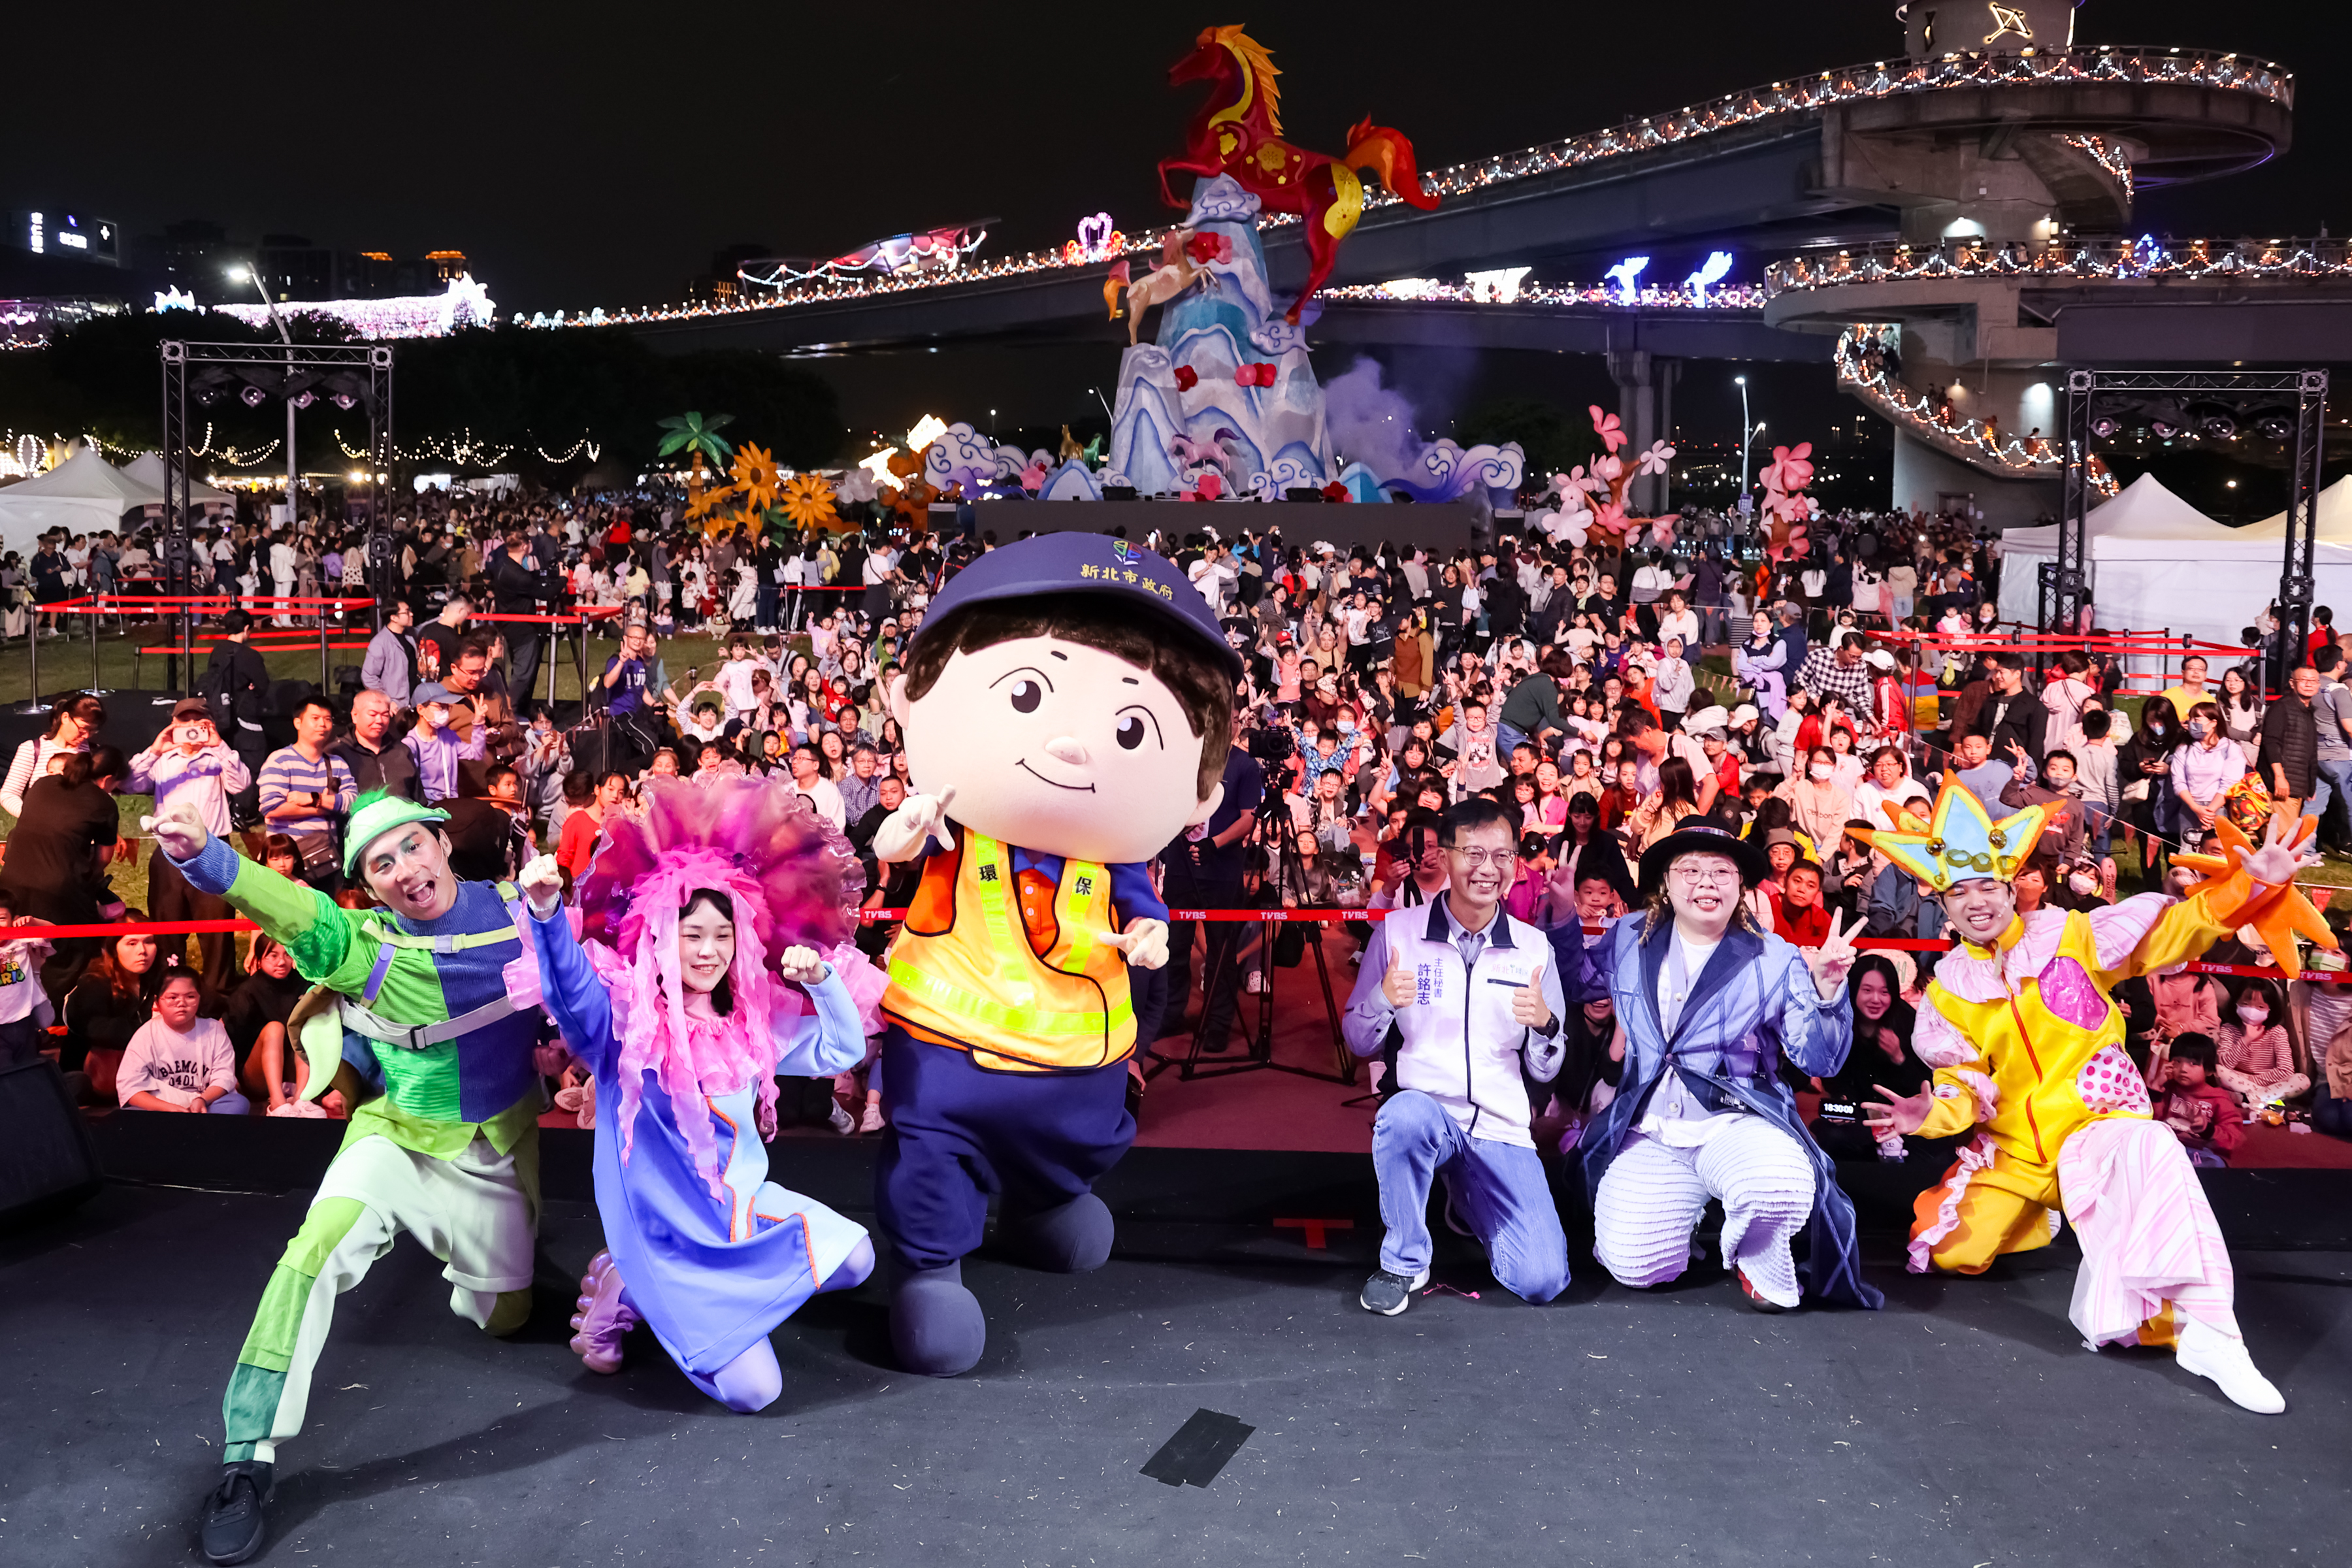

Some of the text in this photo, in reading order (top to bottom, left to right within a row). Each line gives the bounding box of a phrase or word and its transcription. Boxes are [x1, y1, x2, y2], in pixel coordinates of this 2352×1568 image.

[1081, 563, 1173, 600] 新北市政府
[979, 864, 1092, 895] 環 保
[864, 910, 892, 919] TVBS
[1341, 911, 1369, 919] TVBS
[2200, 964, 2233, 973] TVBS
[1433, 958, 1443, 998] 主任秘書
[2299, 972, 2332, 980] TVBS
[1417, 963, 1431, 1005] 許銘志
[169, 1075, 194, 1086] 0401
